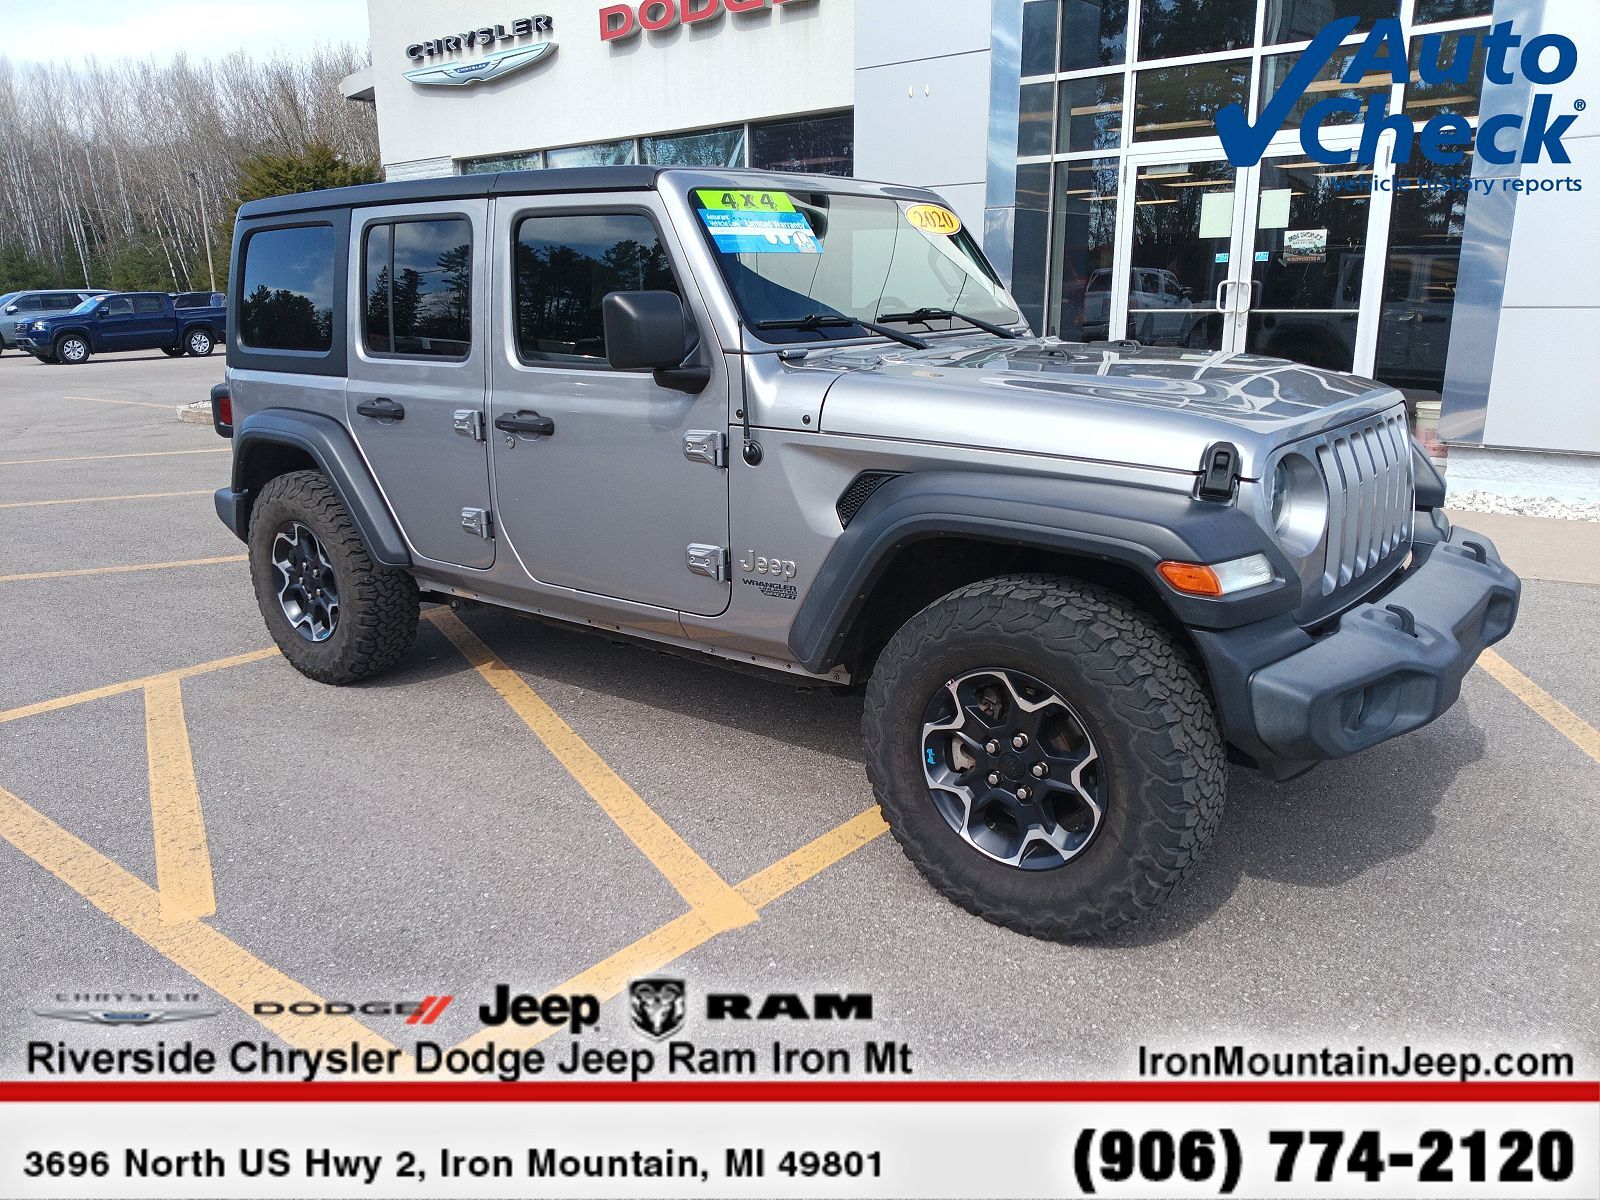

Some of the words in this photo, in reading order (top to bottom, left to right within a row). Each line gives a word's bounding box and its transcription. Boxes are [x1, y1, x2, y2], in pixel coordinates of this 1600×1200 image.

[405, 14, 553, 60] CHRYSLER
[599, 0, 793, 41] DOD
[913, 210, 953, 228] 2020
[740, 549, 797, 582] Jeep
[742, 578, 797, 592] WRANGLER
